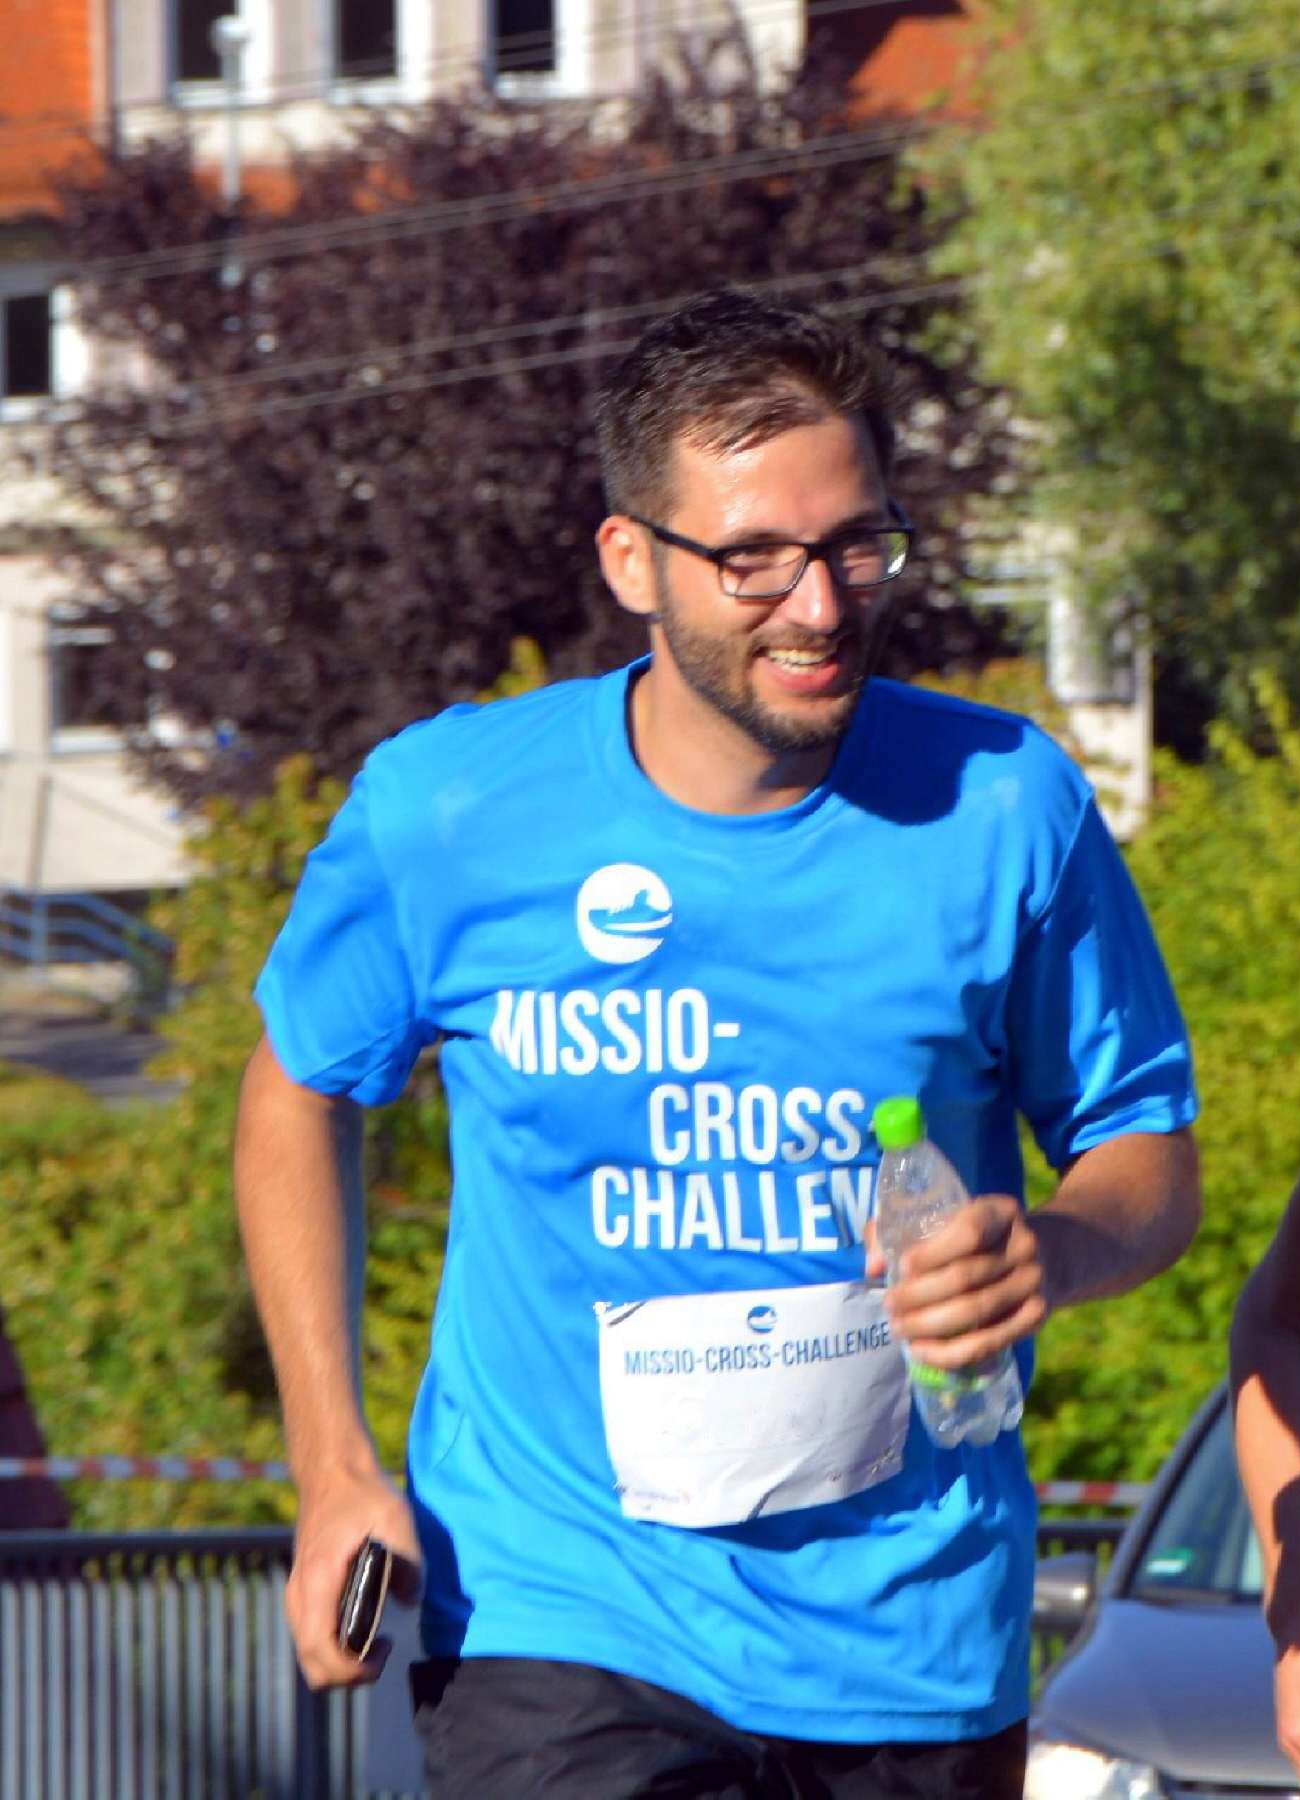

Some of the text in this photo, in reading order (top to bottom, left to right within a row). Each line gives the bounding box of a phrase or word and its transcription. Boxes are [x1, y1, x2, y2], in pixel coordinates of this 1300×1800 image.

[490, 988, 739, 1076] MISSIO-
[648, 1082, 874, 1166] CROSS
[590, 1166, 873, 1254] CHALLEN
[624, 1321, 891, 1376] MISSIO-CROSS-CHALLENGE
